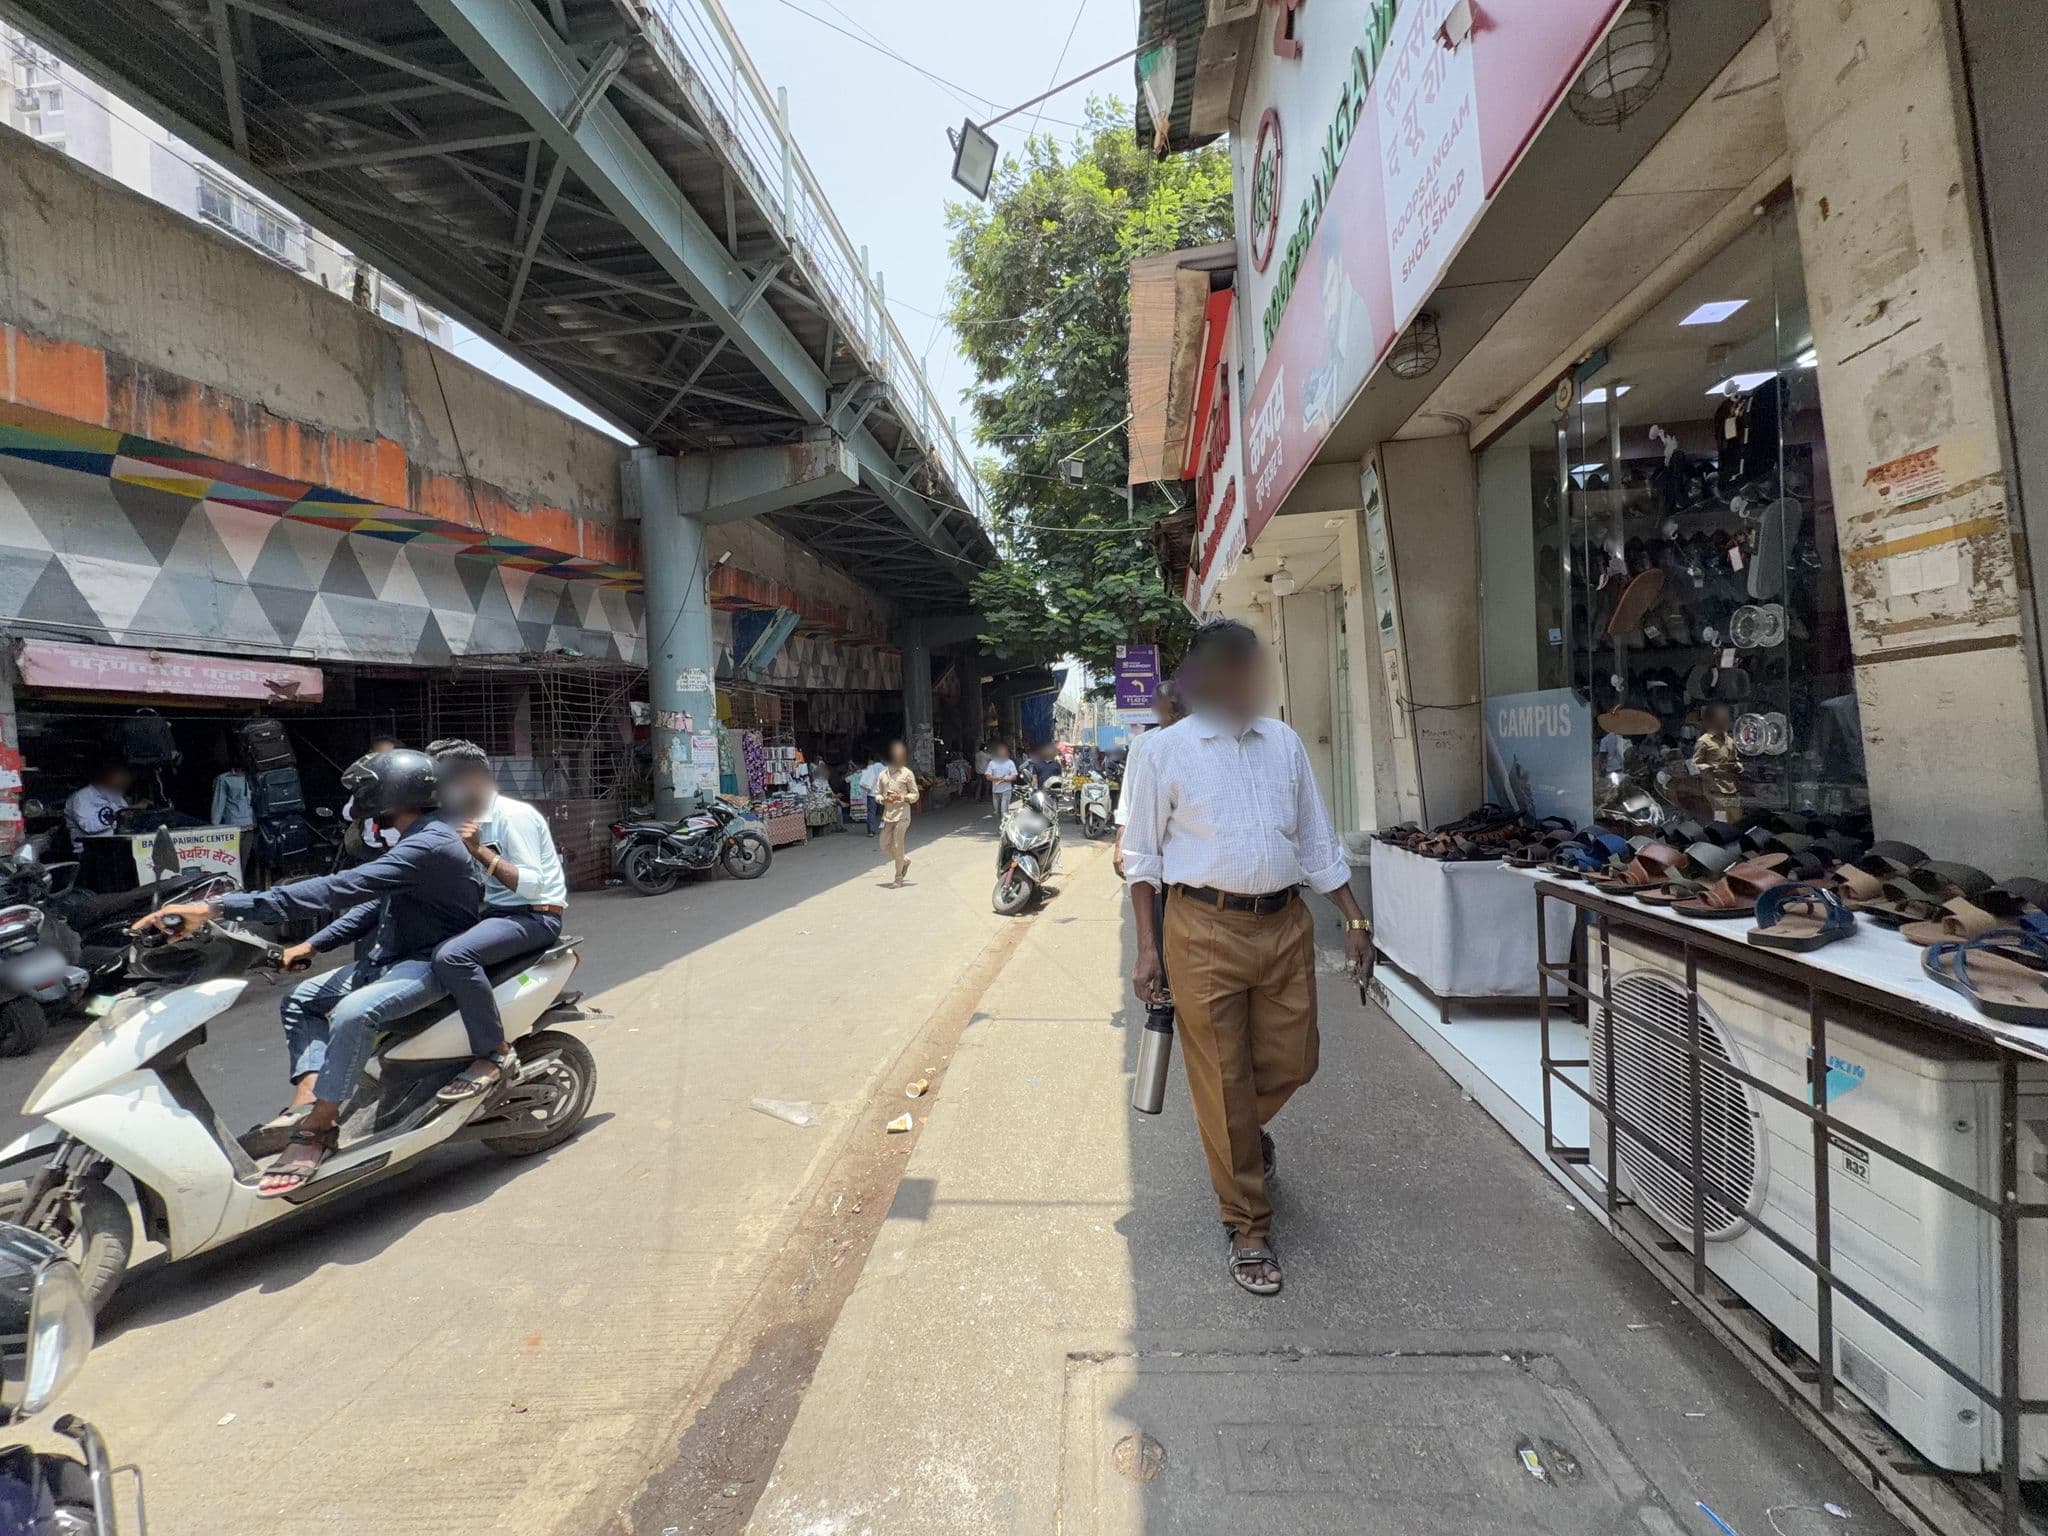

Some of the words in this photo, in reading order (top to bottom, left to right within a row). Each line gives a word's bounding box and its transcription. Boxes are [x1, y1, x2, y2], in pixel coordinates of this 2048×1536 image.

[1391, 93, 1471, 250] ROOPSANGAM
[1417, 179, 1440, 229] THE
[1402, 225, 1431, 284] SHOE
[1432, 168, 1465, 236] SHOP
[1498, 703, 1572, 738] CAMPUS
[173, 835, 205, 845] PAIRING
[206, 833, 235, 843] CENTER
[1845, 1157, 1867, 1180] R32
